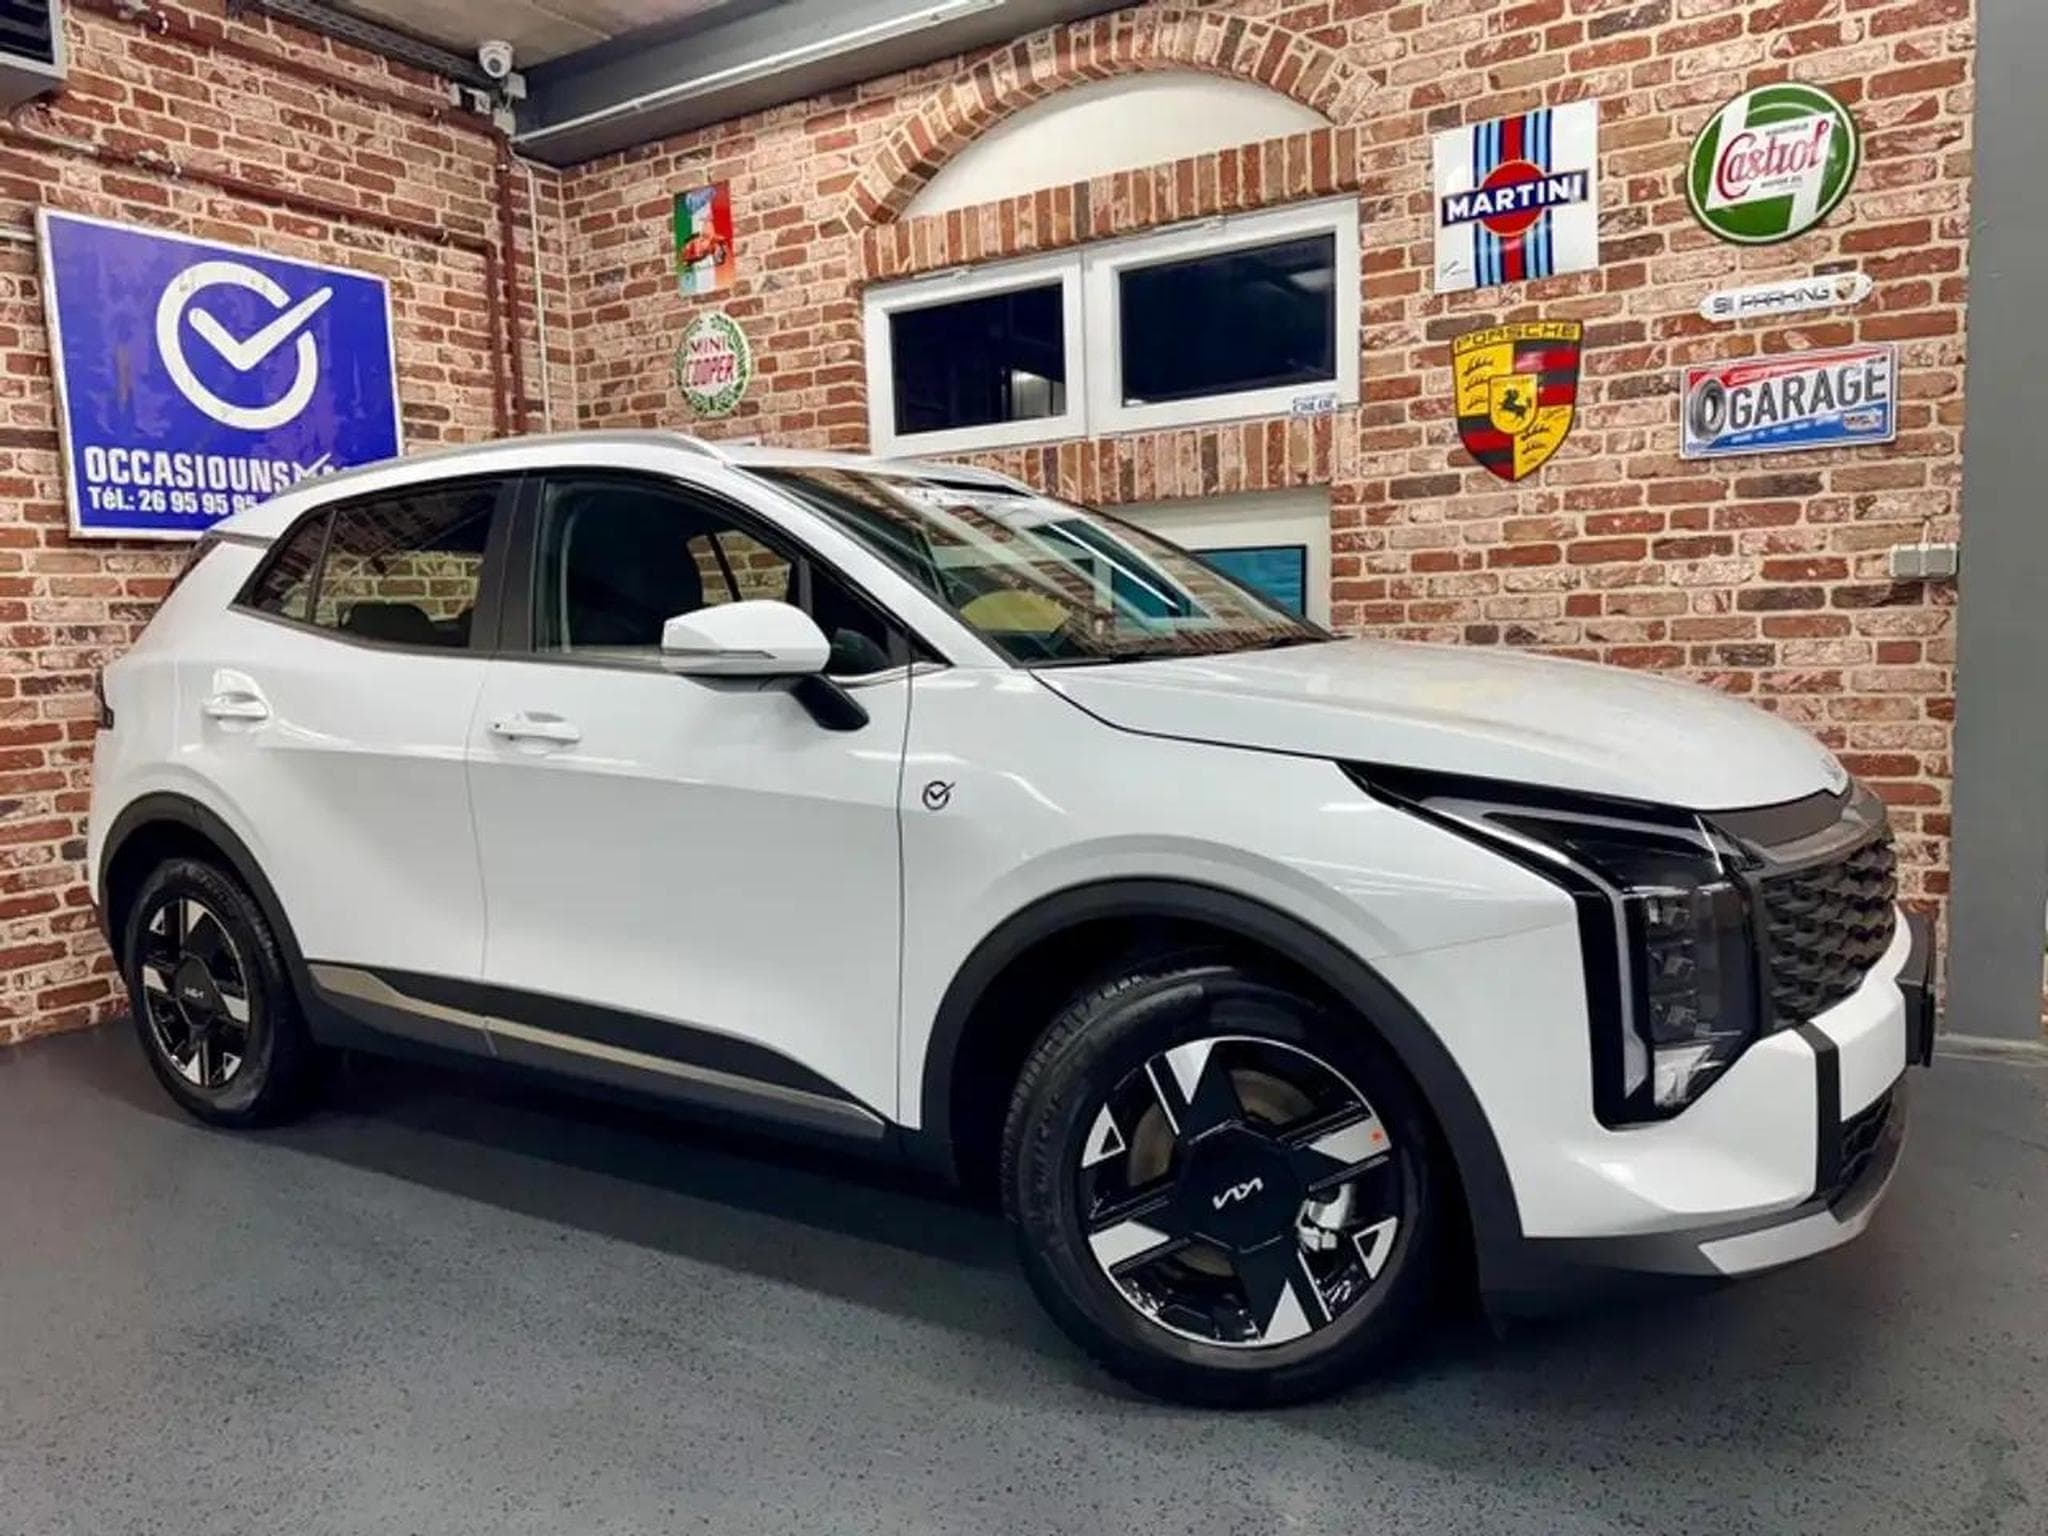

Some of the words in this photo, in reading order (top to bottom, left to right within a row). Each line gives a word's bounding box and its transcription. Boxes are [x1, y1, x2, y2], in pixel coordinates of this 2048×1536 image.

[1716, 119, 1830, 200] Castrol
[1446, 174, 1583, 221] MARTINI
[1456, 322, 1577, 350] PORSCHE
[1730, 363, 1887, 430] GARAGE
[138, 488, 165, 514] 26
[171, 490, 198, 514] 95
[202, 491, 229, 516] 95
